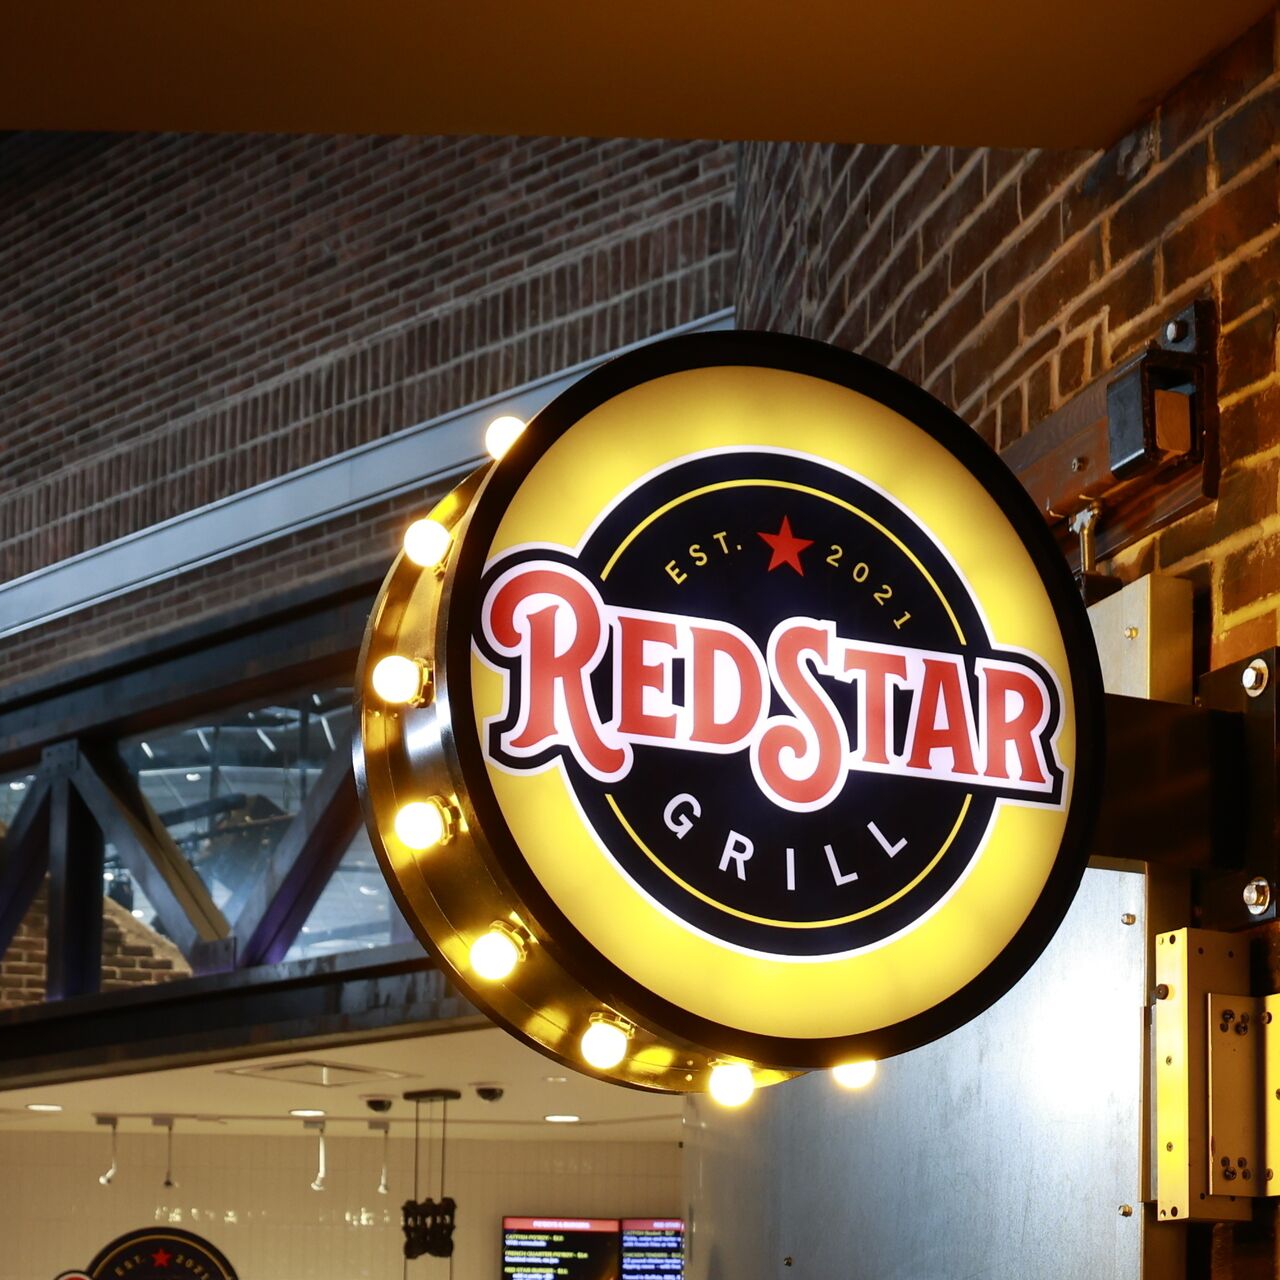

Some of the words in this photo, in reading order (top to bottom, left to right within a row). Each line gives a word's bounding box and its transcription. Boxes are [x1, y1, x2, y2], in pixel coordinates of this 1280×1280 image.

[663, 530, 743, 586] EST.
[826, 543, 912, 631] 2021
[663, 791, 908, 892] GRILL
[175, 1254, 210, 1280] 2021
